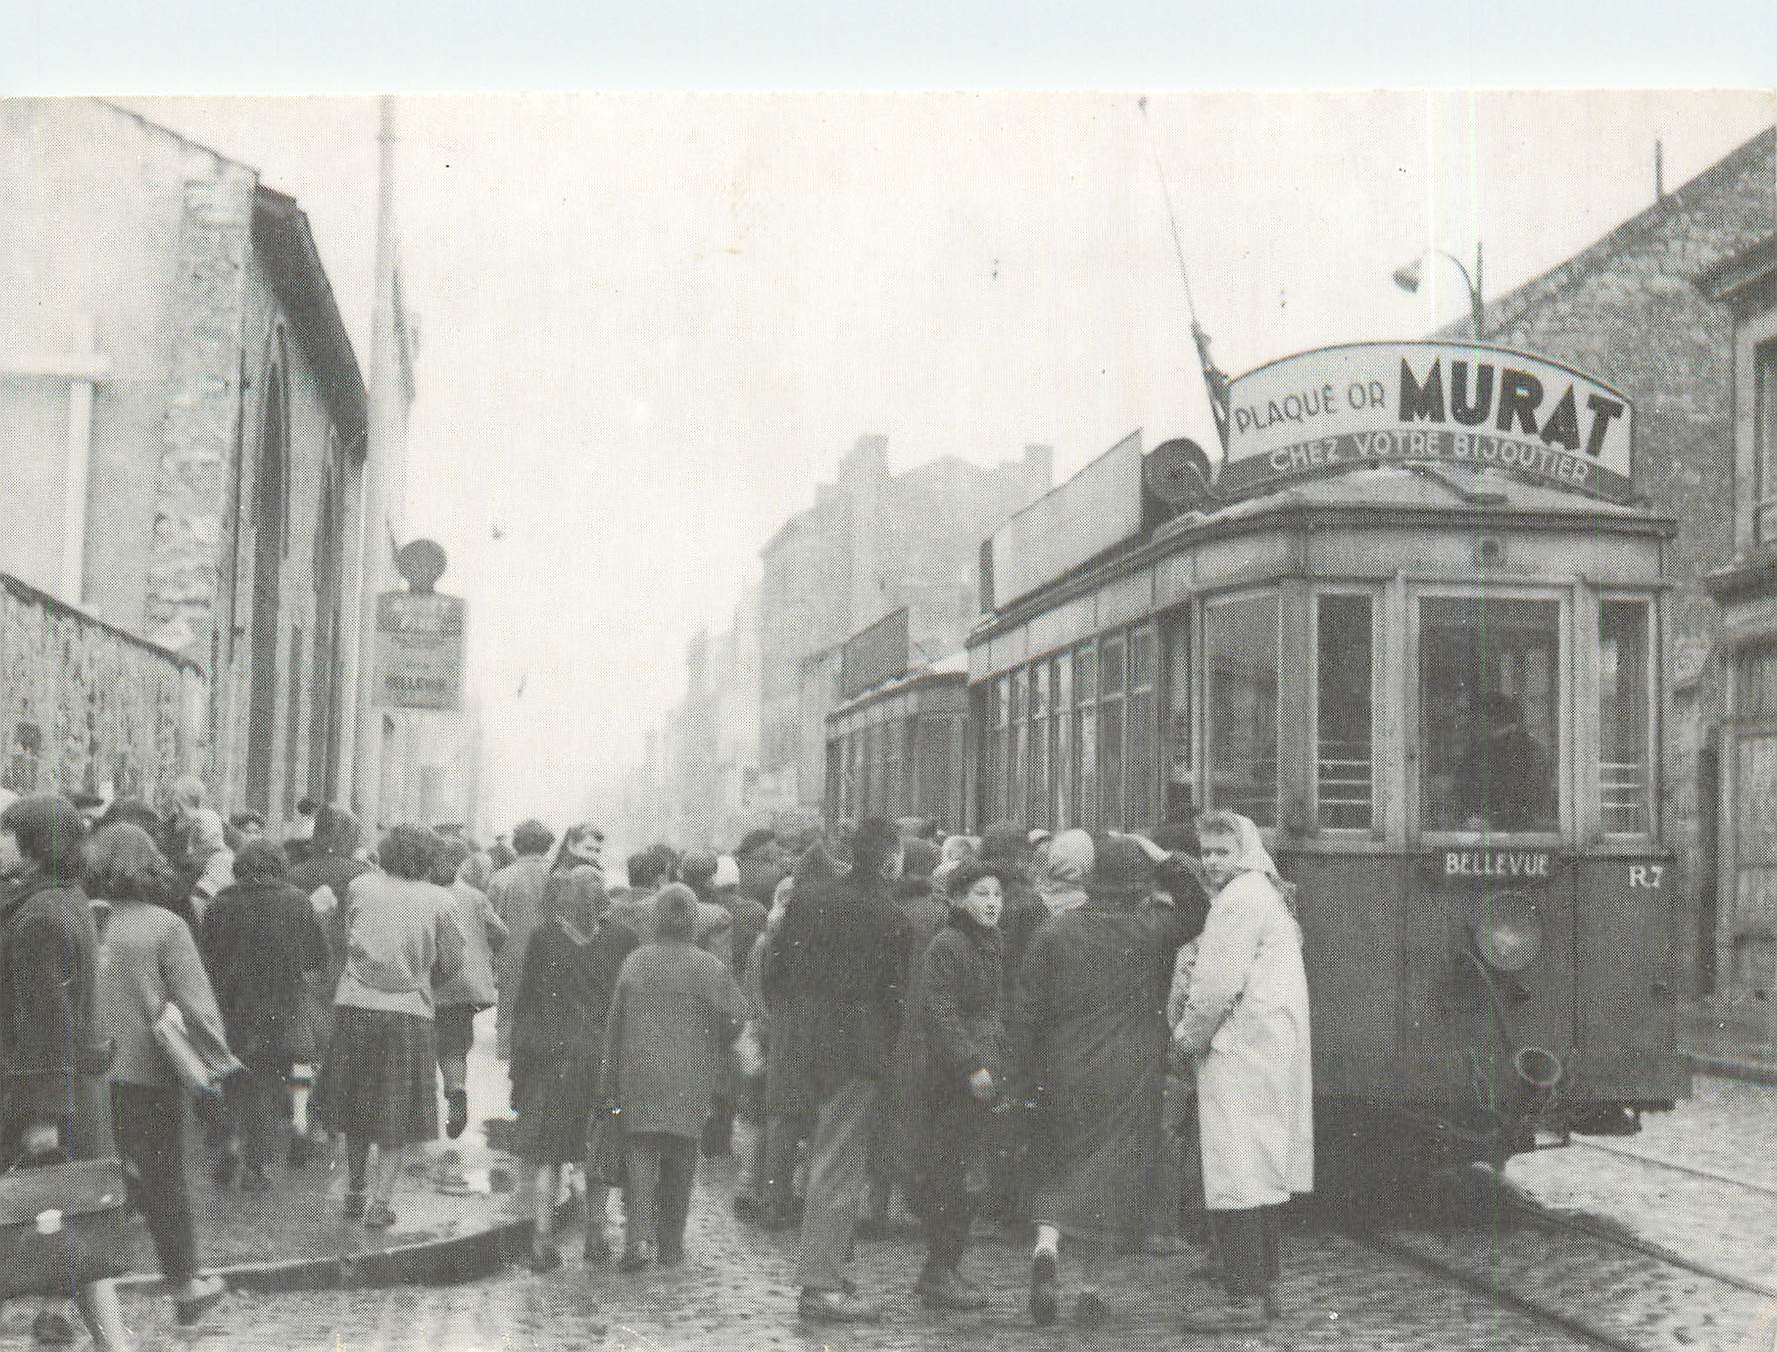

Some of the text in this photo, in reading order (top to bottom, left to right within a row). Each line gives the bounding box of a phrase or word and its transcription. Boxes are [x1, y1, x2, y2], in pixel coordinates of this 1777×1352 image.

[1348, 381, 1386, 410] OR
[1399, 356, 1625, 457] MURAT
[1270, 428, 1589, 487] CHEZ VOTRE BIJOUTIER
[1446, 852, 1550, 877] BELLEVUE
